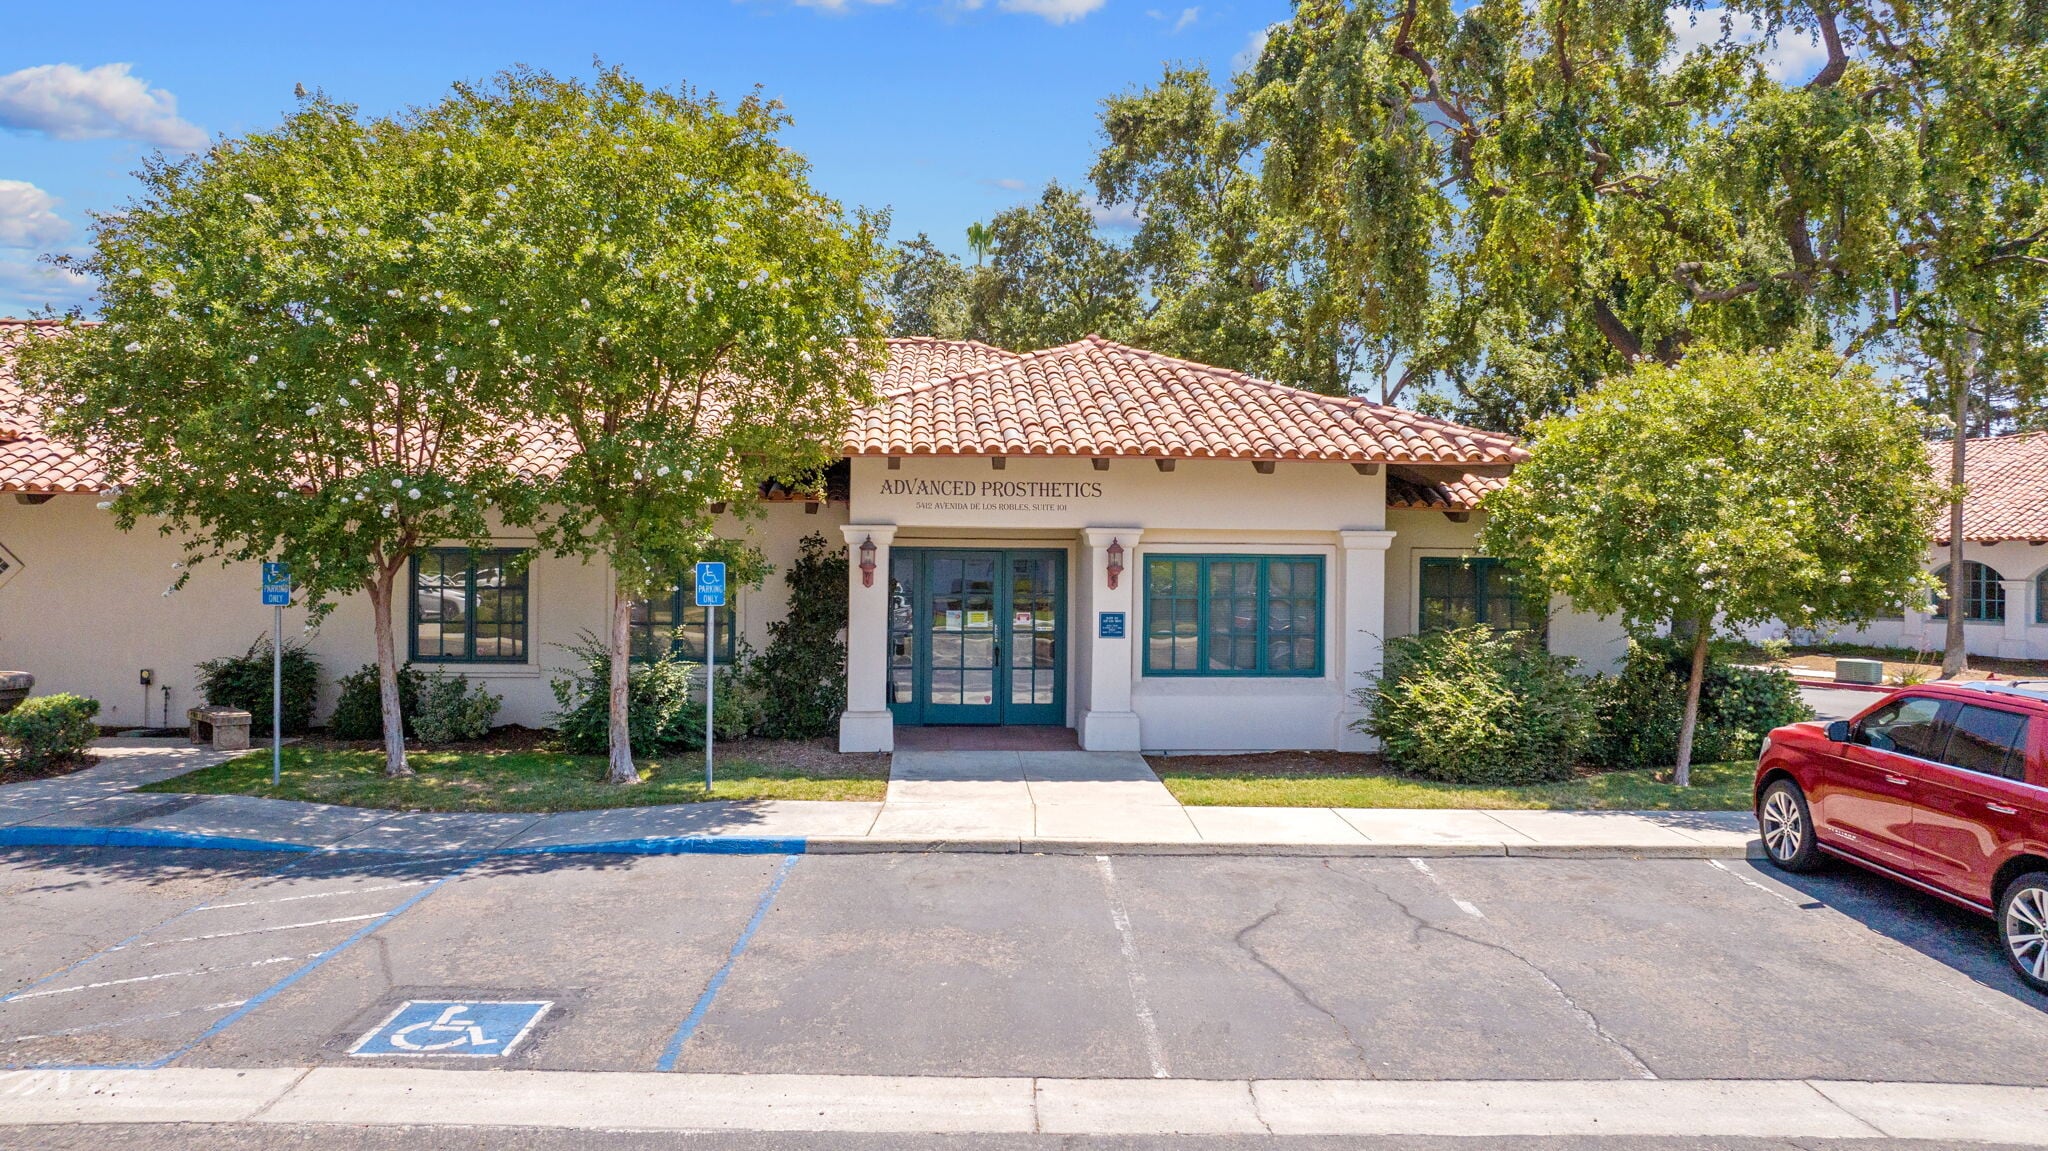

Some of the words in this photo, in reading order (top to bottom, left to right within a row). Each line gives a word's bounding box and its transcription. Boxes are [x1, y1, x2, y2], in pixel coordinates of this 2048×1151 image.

[880, 478, 976, 496] ADVANCED
[981, 481, 1102, 498] PROSTHETICS
[915, 502, 933, 510] 5412
[934, 502, 968, 510] AVENIDA
[982, 503, 997, 511] LOS
[1032, 503, 1056, 511] SUITE
[1057, 503, 1067, 511] 101
[698, 585, 723, 593] PARKING
[703, 595, 718, 603] ONLY
